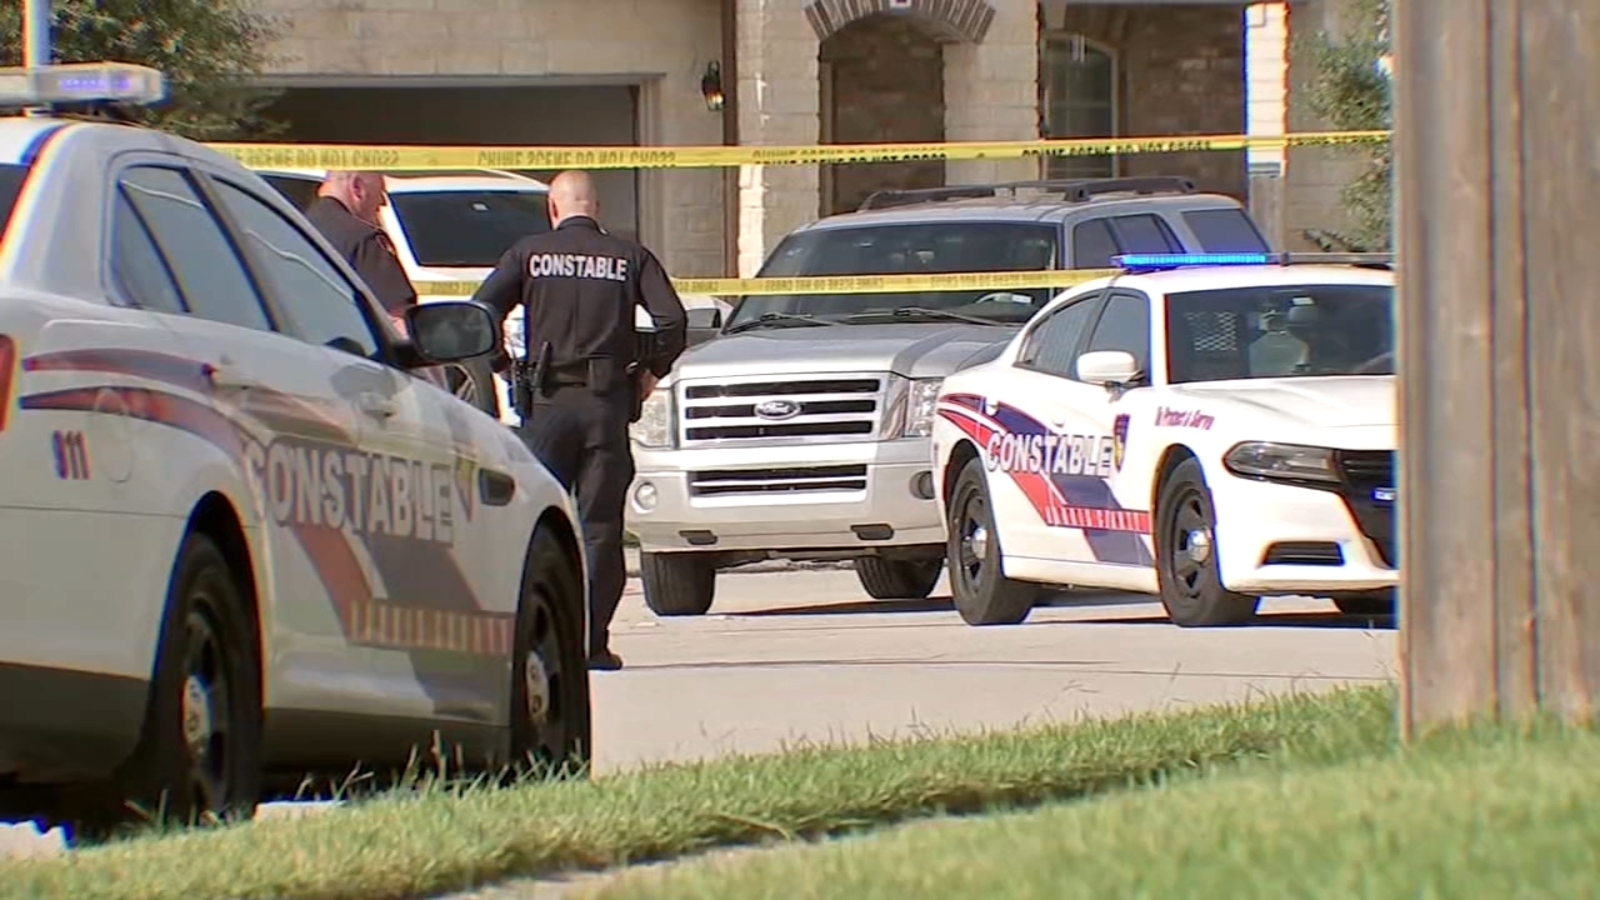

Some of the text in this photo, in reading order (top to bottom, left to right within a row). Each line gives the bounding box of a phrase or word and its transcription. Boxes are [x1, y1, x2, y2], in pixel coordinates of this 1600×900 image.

[528, 253, 628, 282] CONSTABLE
[986, 430, 1114, 478] CONSTABLE
[242, 436, 456, 547] CONSTABLE
